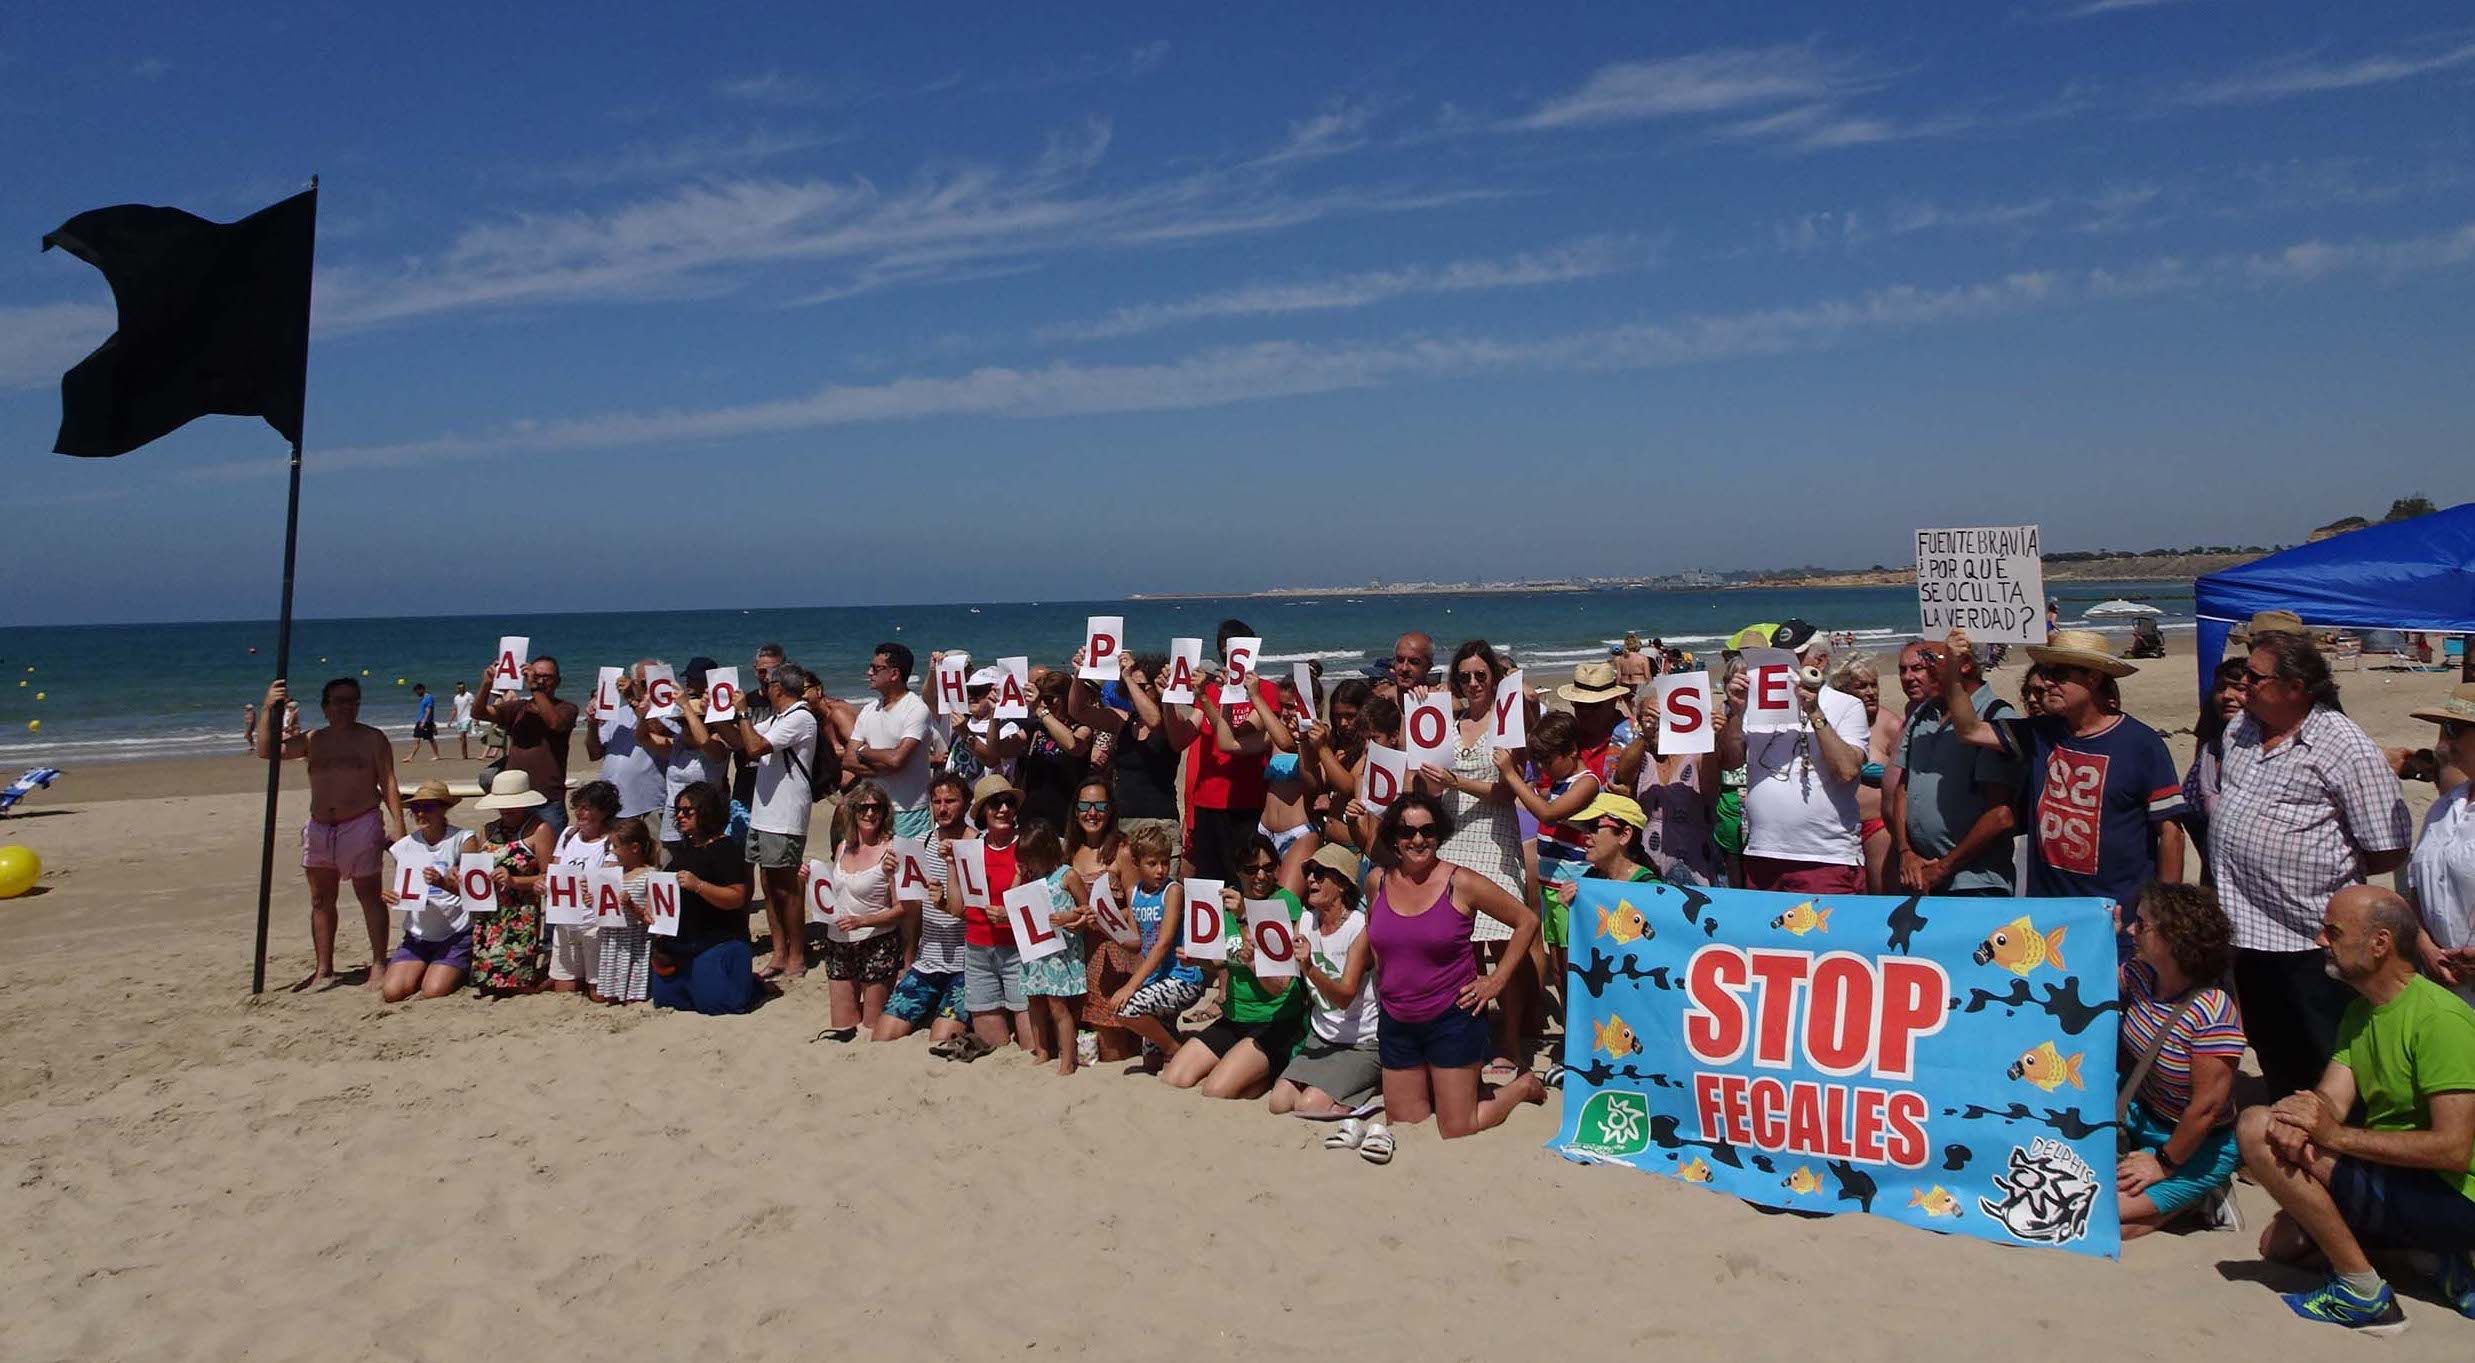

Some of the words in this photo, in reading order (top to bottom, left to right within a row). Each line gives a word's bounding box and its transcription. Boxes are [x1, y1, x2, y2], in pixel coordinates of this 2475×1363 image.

[1963, 554, 2008, 580] QUÉ
[1921, 582, 1942, 603] SE
[1946, 581, 2026, 604] OCULTA
[1923, 608, 1942, 628] LA
[497, 651, 518, 680] A
[1089, 633, 1116, 666] P
[1229, 647, 1251, 686] S
[940, 671, 965, 702] H
[1000, 675, 1025, 707] A
[1170, 655, 1194, 692] A
[1757, 664, 1789, 710] E
[598, 681, 615, 711] L
[648, 678, 673, 708] G
[711, 681, 736, 712] O
[1666, 687, 1703, 732] S
[1409, 705, 1447, 749] O
[1495, 691, 1517, 736] Y
[1367, 762, 1398, 806] D
[2048, 758, 2100, 807] 92
[2040, 811, 2091, 860] PS
[400, 869, 421, 901] L
[464, 868, 492, 900] O
[900, 855, 929, 888] A
[961, 859, 983, 896] L
[550, 875, 578, 909] H
[599, 884, 621, 917] A
[652, 882, 676, 917] N
[814, 878, 835, 915] C
[1019, 905, 1056, 945] L
[1096, 896, 1129, 933] A
[1190, 899, 1221, 944] D
[1254, 919, 1294, 962] O
[1685, 945, 1948, 1080] STOP
[1695, 1073, 1928, 1167] FECALES
[2032, 1138, 2094, 1185] DELPHIS
